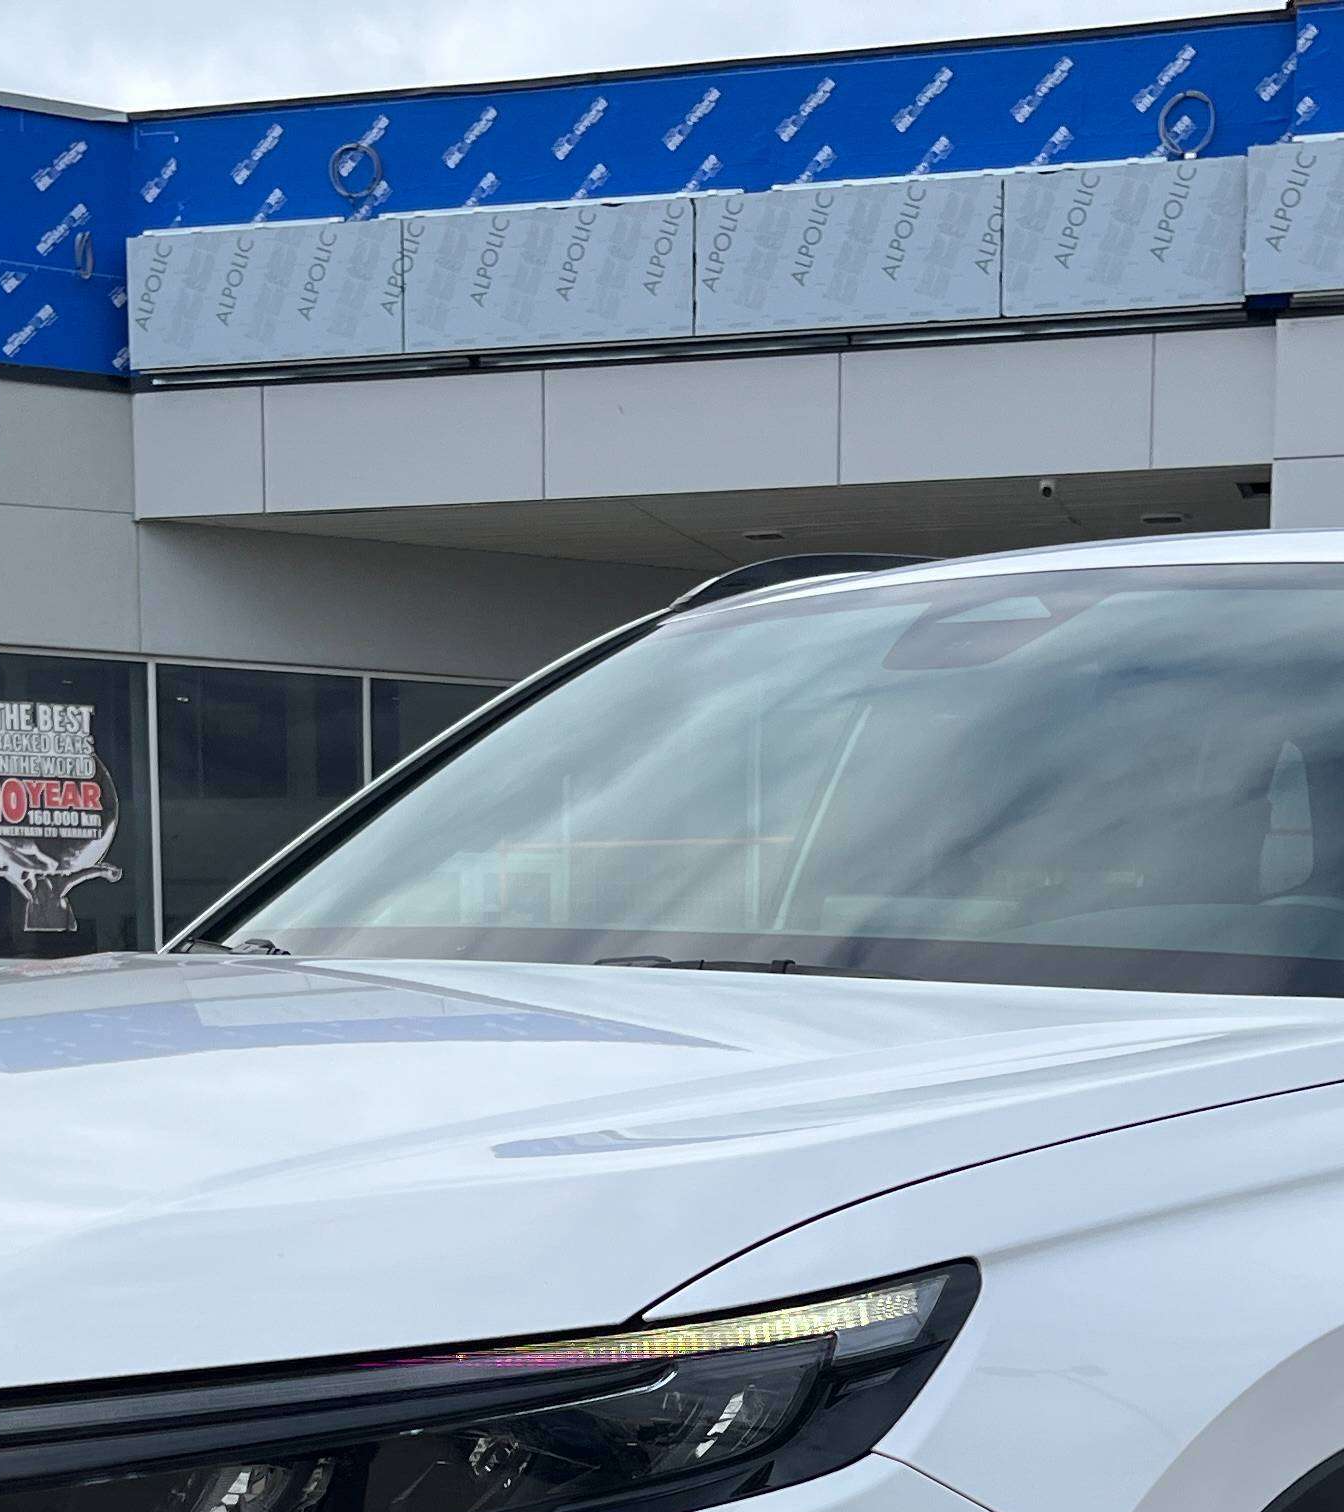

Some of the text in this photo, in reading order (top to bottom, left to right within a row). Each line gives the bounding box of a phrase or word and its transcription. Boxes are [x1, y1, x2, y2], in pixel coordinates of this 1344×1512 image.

[702, 199, 744, 293] ALPOLIC
[791, 191, 834, 287] ALPOLIC
[882, 184, 926, 281] ALPOLIC
[1054, 170, 1101, 269] ALPOLIC
[1150, 164, 1197, 263] ALPOLIC
[1265, 151, 1317, 252] ALPOLIC
[135, 242, 173, 332] ALPOLIC
[215, 236, 254, 326] ALPOLIC
[297, 227, 337, 321] ALPOLIC
[380, 222, 425, 316] ALPOLIC
[470, 215, 510, 308] ALPOLIC
[556, 208, 597, 302] ALPOLIC
[643, 203, 685, 297] ALPOLIC
[37, 704, 94, 736] BEST
[55, 734, 94, 754] CARS
[24, 780, 103, 810] YEAR
[81, 811, 102, 828] km
